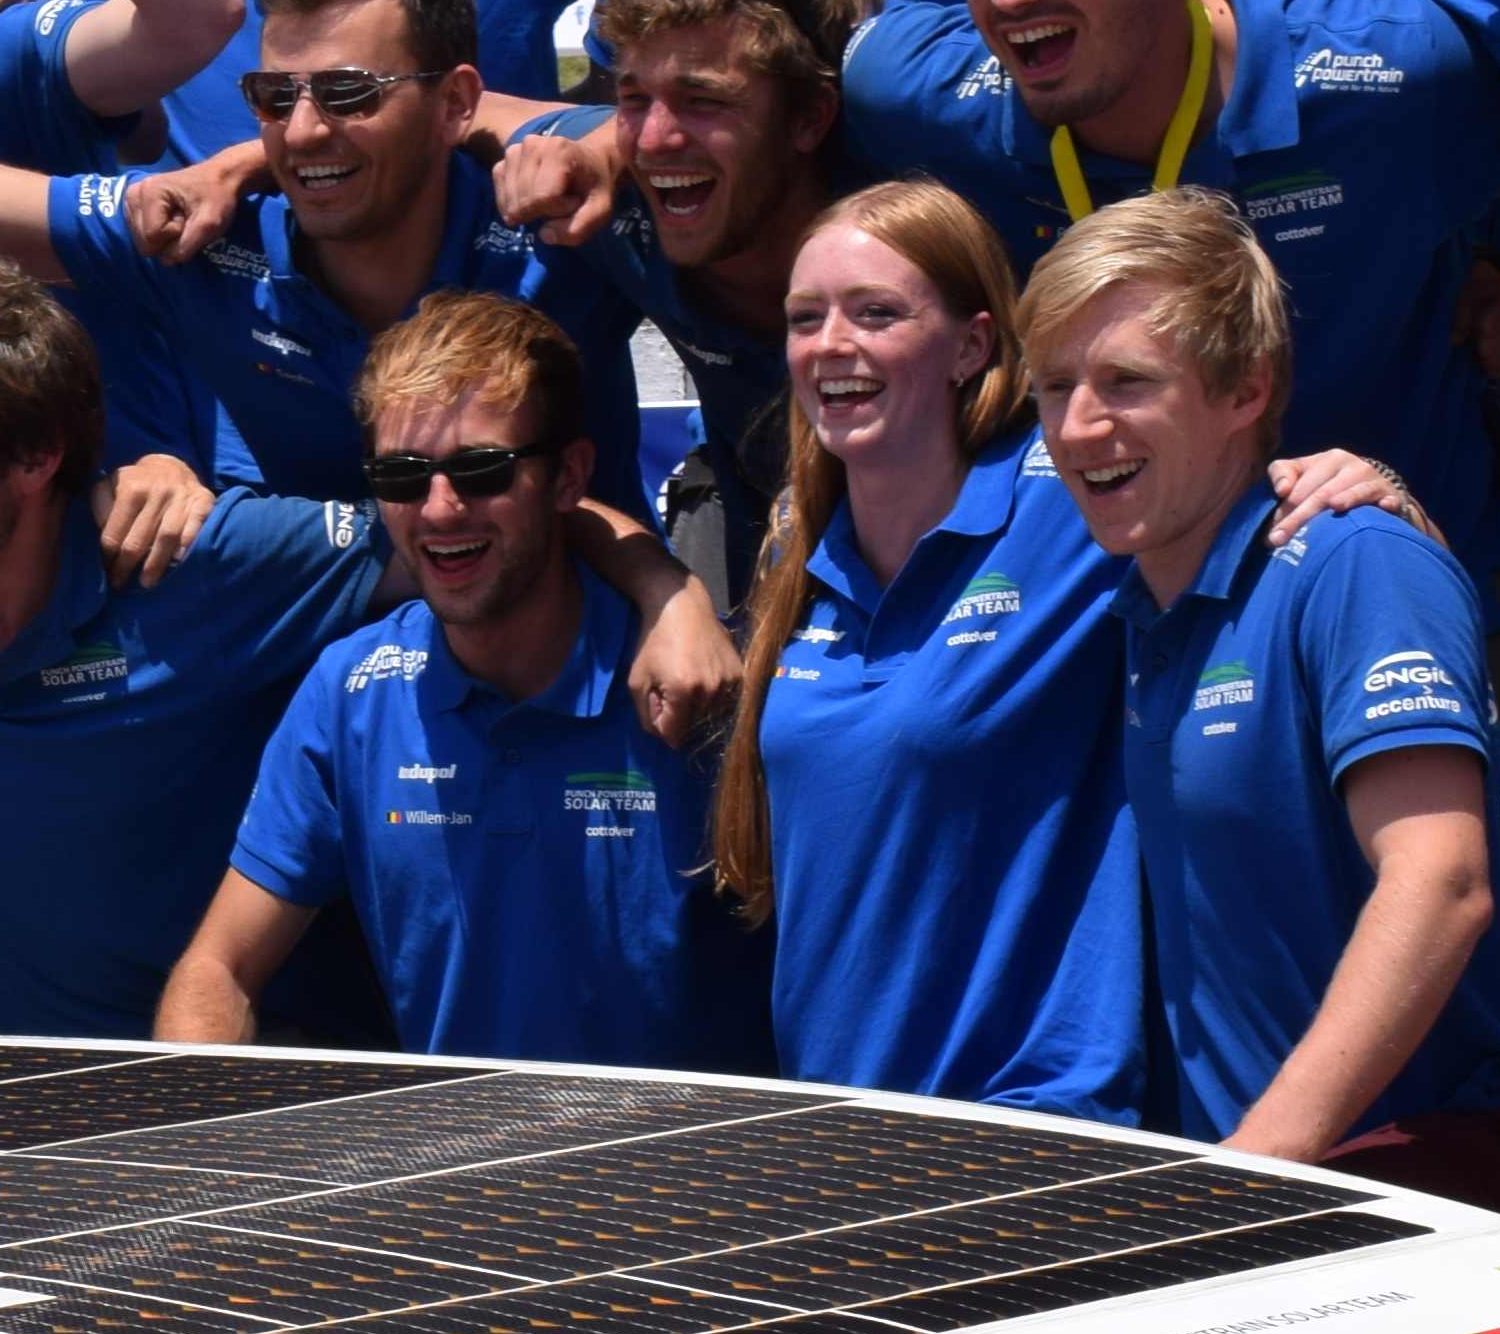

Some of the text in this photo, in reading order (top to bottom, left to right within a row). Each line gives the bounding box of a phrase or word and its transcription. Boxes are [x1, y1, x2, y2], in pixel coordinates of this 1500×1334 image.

[1331, 50, 1383, 69] punch
[1310, 66, 1404, 85] powertrain
[1247, 192, 1344, 222] SOLAR TEAM
[1274, 224, 1326, 243] cottover
[974, 598, 1021, 615] TEAM
[42, 665, 129, 687] SOLAR TEAM
[1364, 693, 1461, 720] accenture
[563, 797, 657, 812] SOLAR TEAM
[564, 788, 657, 802] PUNCH POWERTRAIN
[405, 809, 472, 825] Willem-Jan
[585, 824, 636, 837] cottover
